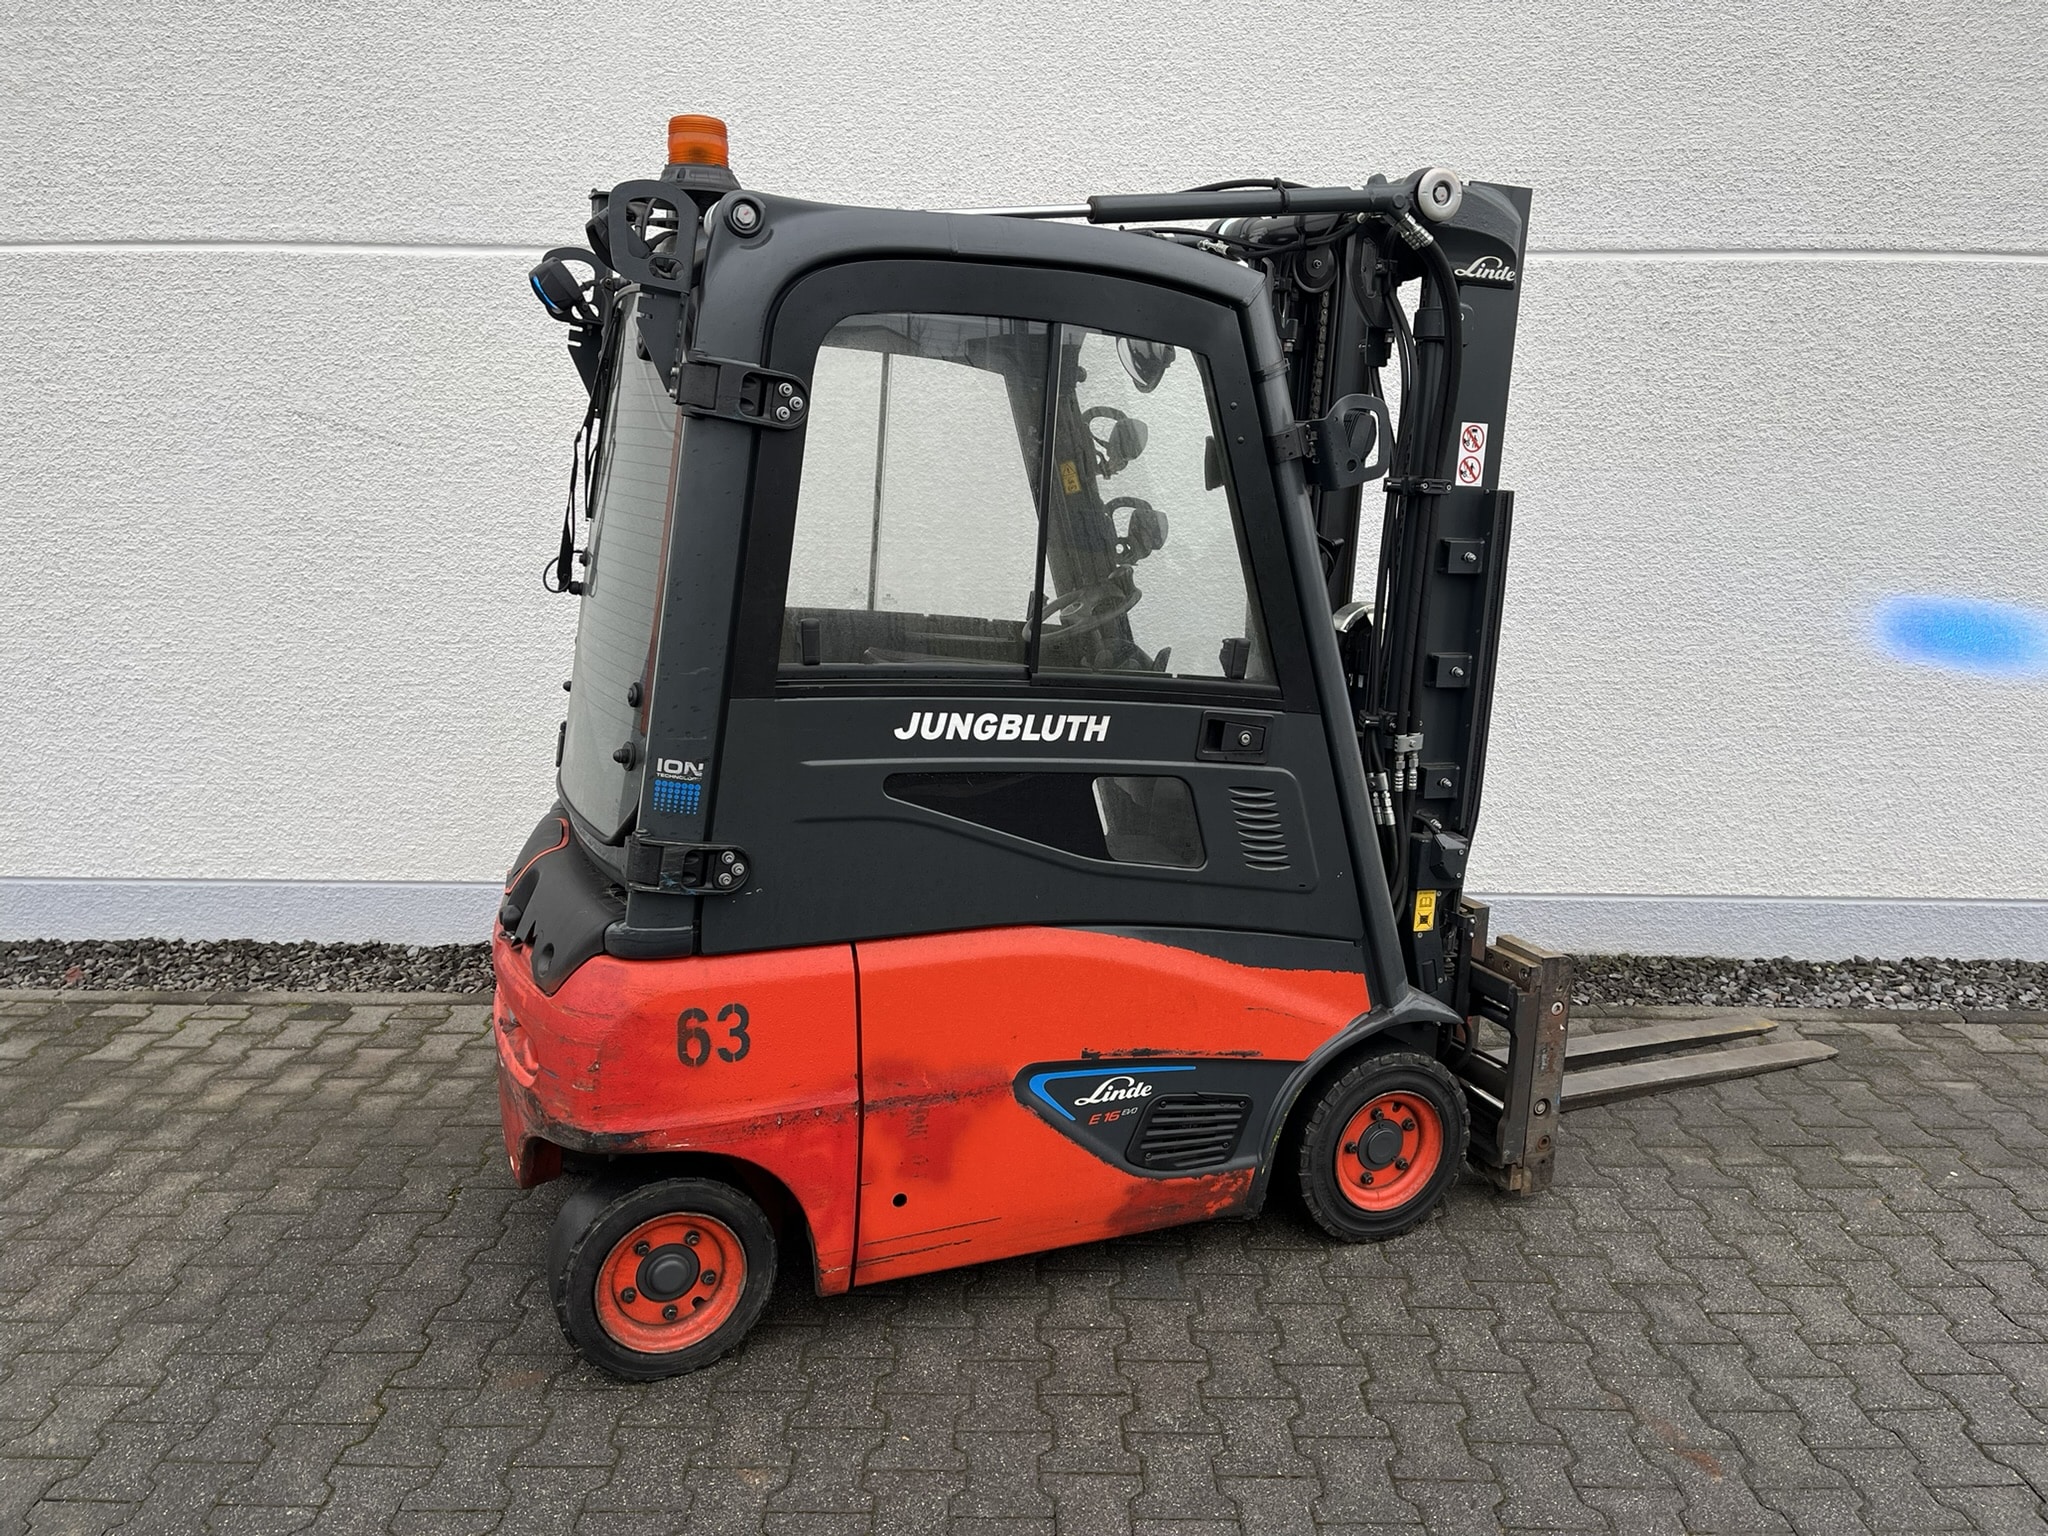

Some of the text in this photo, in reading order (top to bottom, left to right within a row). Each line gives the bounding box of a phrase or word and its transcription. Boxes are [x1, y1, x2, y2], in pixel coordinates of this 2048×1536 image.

[1454, 255, 1517, 282] Linde
[893, 712, 1112, 743] JUNGBLUTH
[656, 757, 705, 777] ION
[656, 772, 703, 781] TECHNOLO
[677, 1003, 751, 1067] 63
[1074, 1075, 1153, 1107] Linde
[1088, 1113, 1102, 1126] E
[1103, 1110, 1121, 1123] 16
